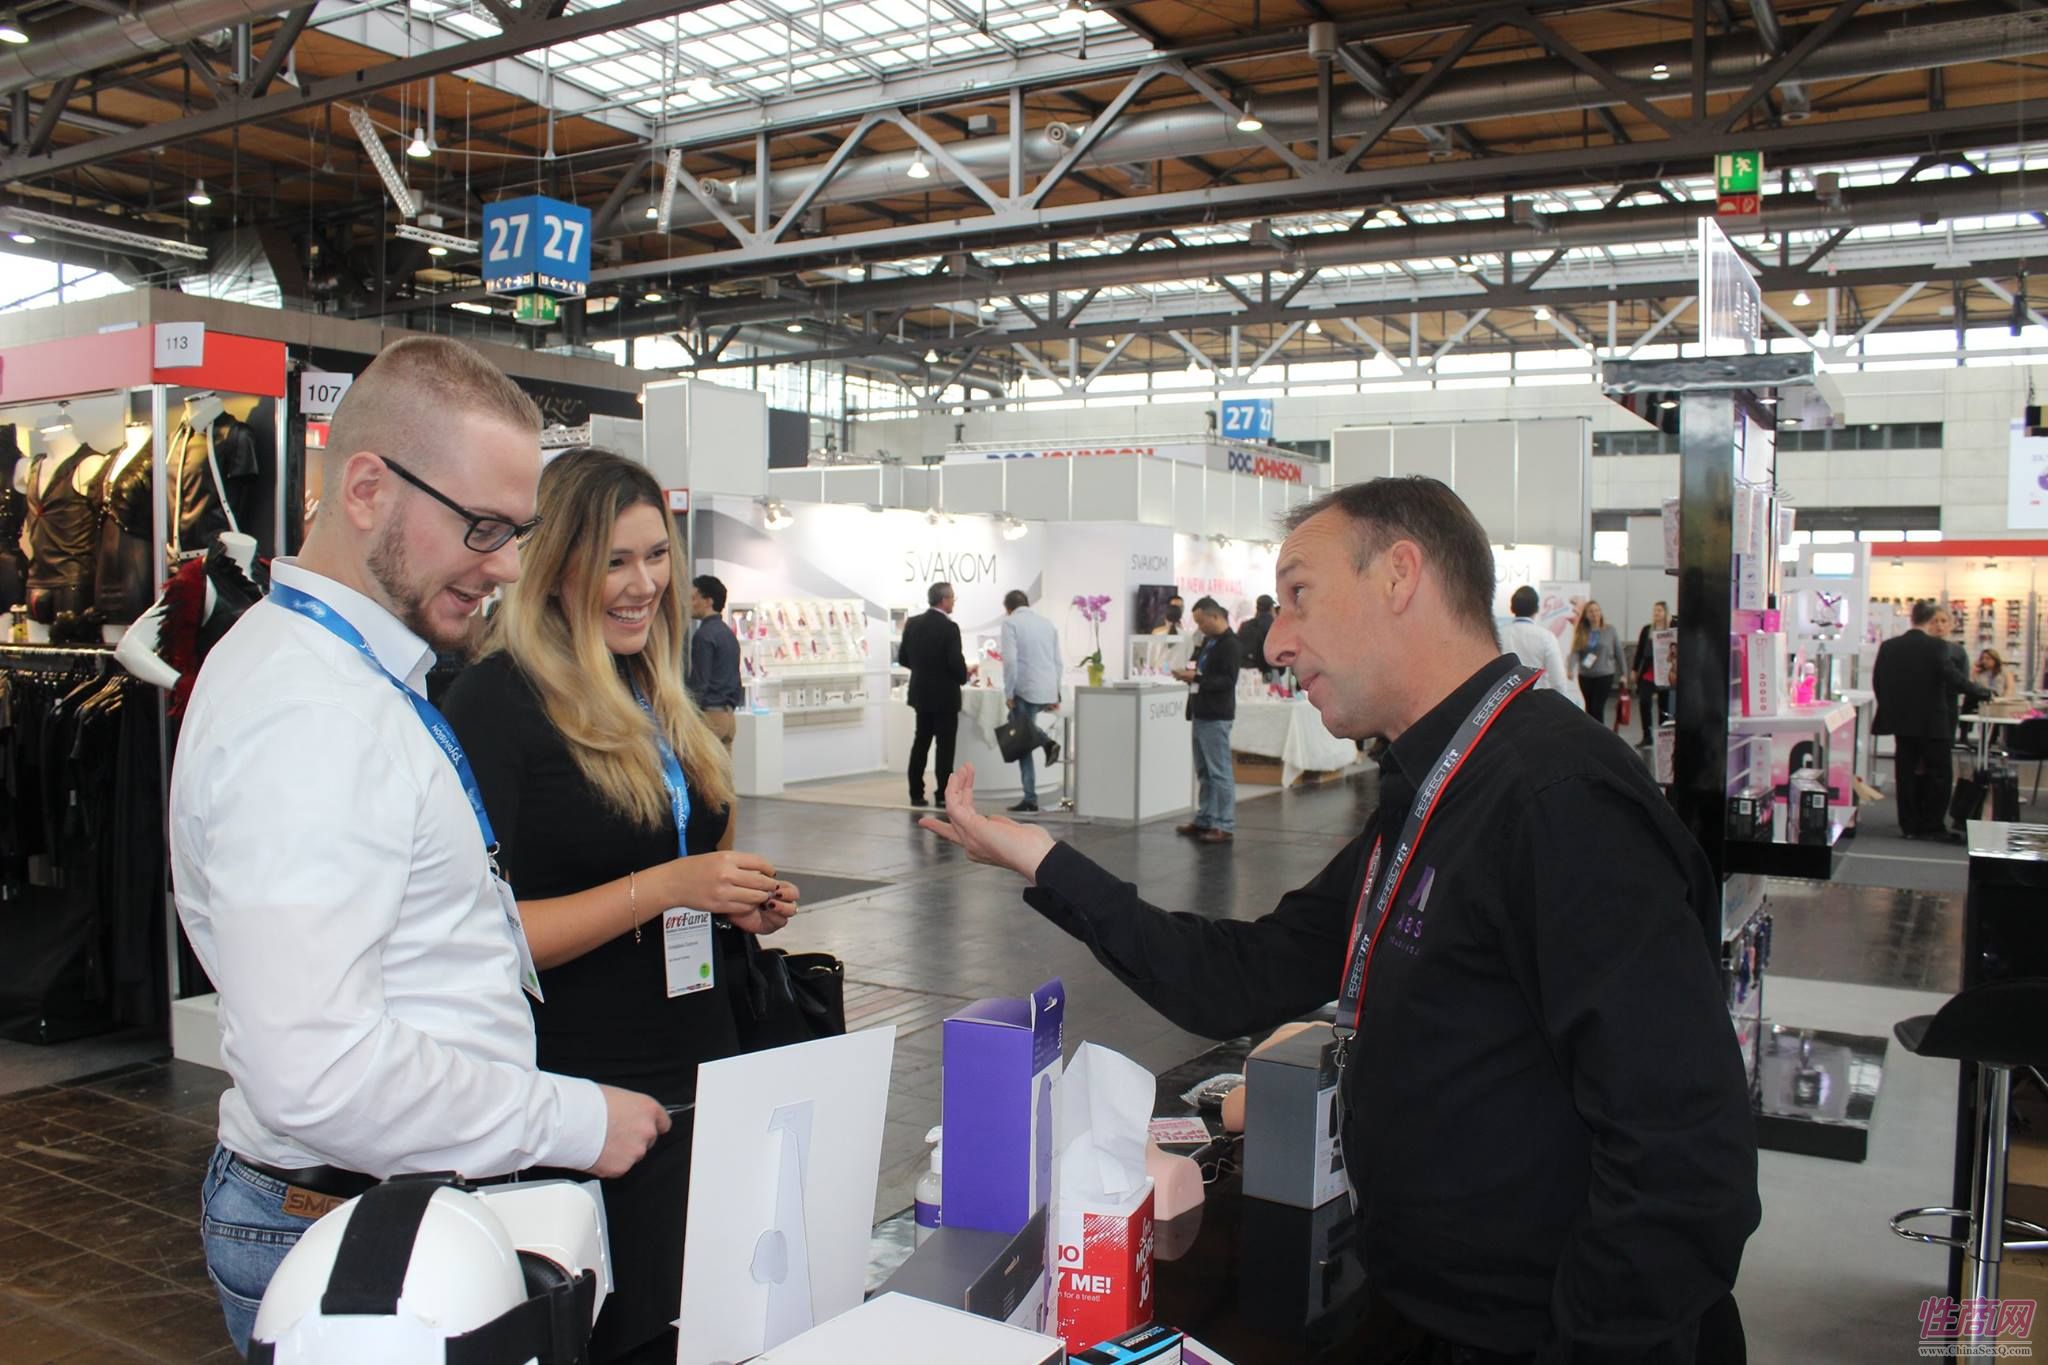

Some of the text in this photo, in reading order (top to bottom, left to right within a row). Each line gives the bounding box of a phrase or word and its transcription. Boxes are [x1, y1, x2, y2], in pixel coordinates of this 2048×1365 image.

[489, 214, 530, 262] 27
[543, 215, 584, 264] 27
[166, 336, 188, 350] 113
[308, 384, 341, 403] 107
[1226, 406, 1255, 430] 27
[1260, 407, 1271, 432] 27
[904, 551, 997, 584] SVAKOM
[1131, 554, 1168, 571] SVAKOM
[1071, 1273, 1112, 1294] ME!
